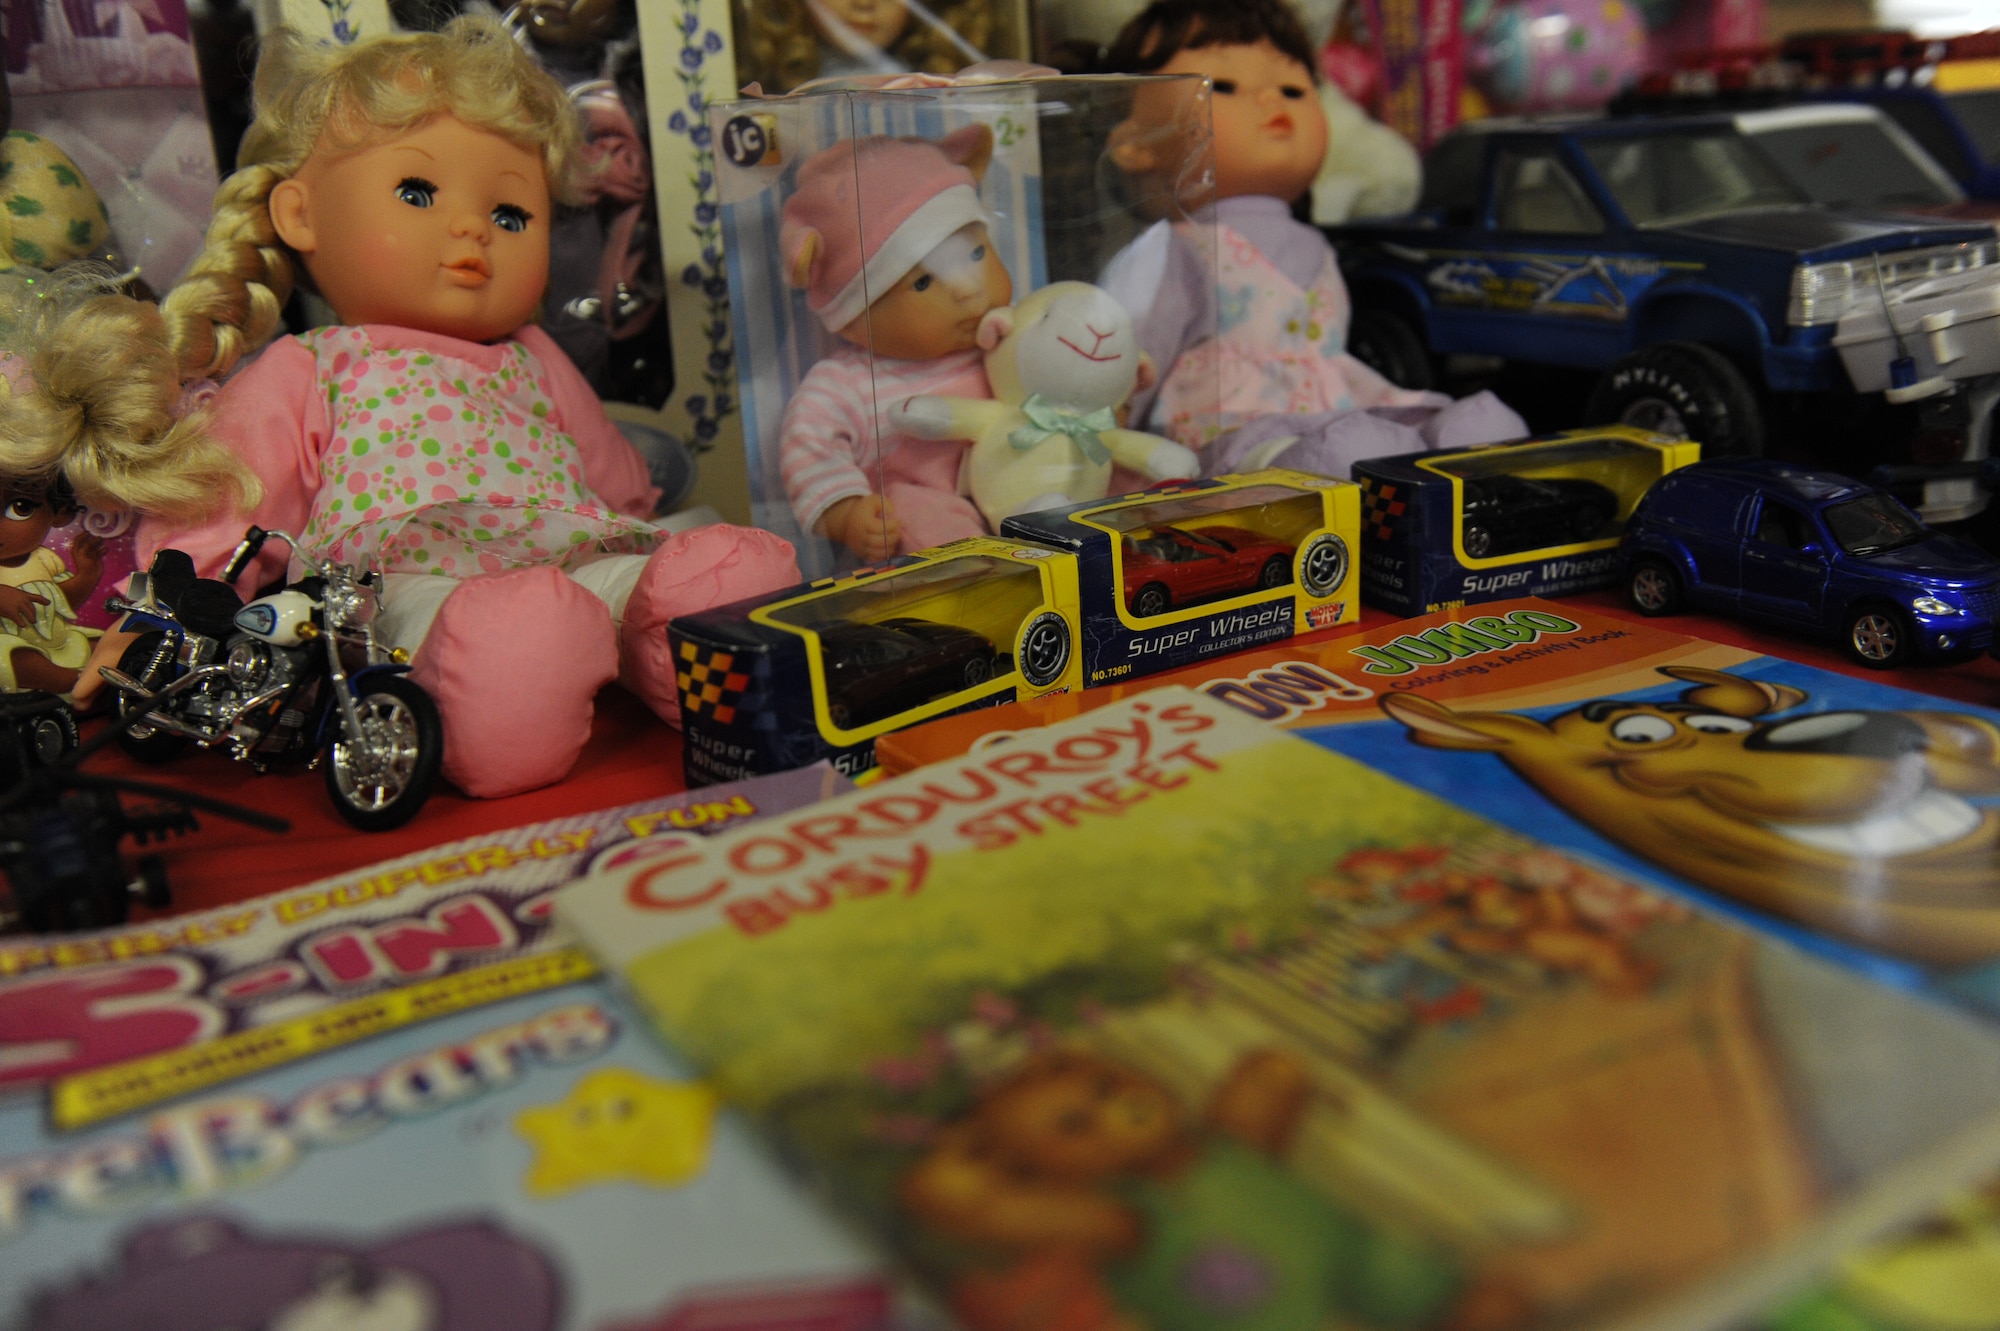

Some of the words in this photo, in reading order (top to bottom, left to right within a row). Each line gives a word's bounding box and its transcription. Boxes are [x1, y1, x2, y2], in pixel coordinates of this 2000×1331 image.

[995, 115, 1027, 146] 2+
[1461, 570, 1533, 594] Super
[1310, 602, 1340, 618] MOTOR
[1127, 627, 1201, 658] Super
[1209, 604, 1293, 638] Wheels
[1199, 633, 1253, 654] COLLECTOR'S
[1254, 625, 1287, 640] EDITION
[1349, 610, 1581, 676] JUMBO
[1091, 662, 1133, 682] NO.73601
[1390, 662, 1489, 692] Coloring
[1487, 660, 1501, 669] &
[1500, 640, 1581, 664] Activity
[1574, 628, 1633, 645] Book
[689, 725, 757, 762] Super
[622, 794, 757, 839] FUN
[626, 700, 1217, 911] CORDUROY'S
[723, 844, 932, 938] BUSY
[957, 741, 1222, 851] STREET
